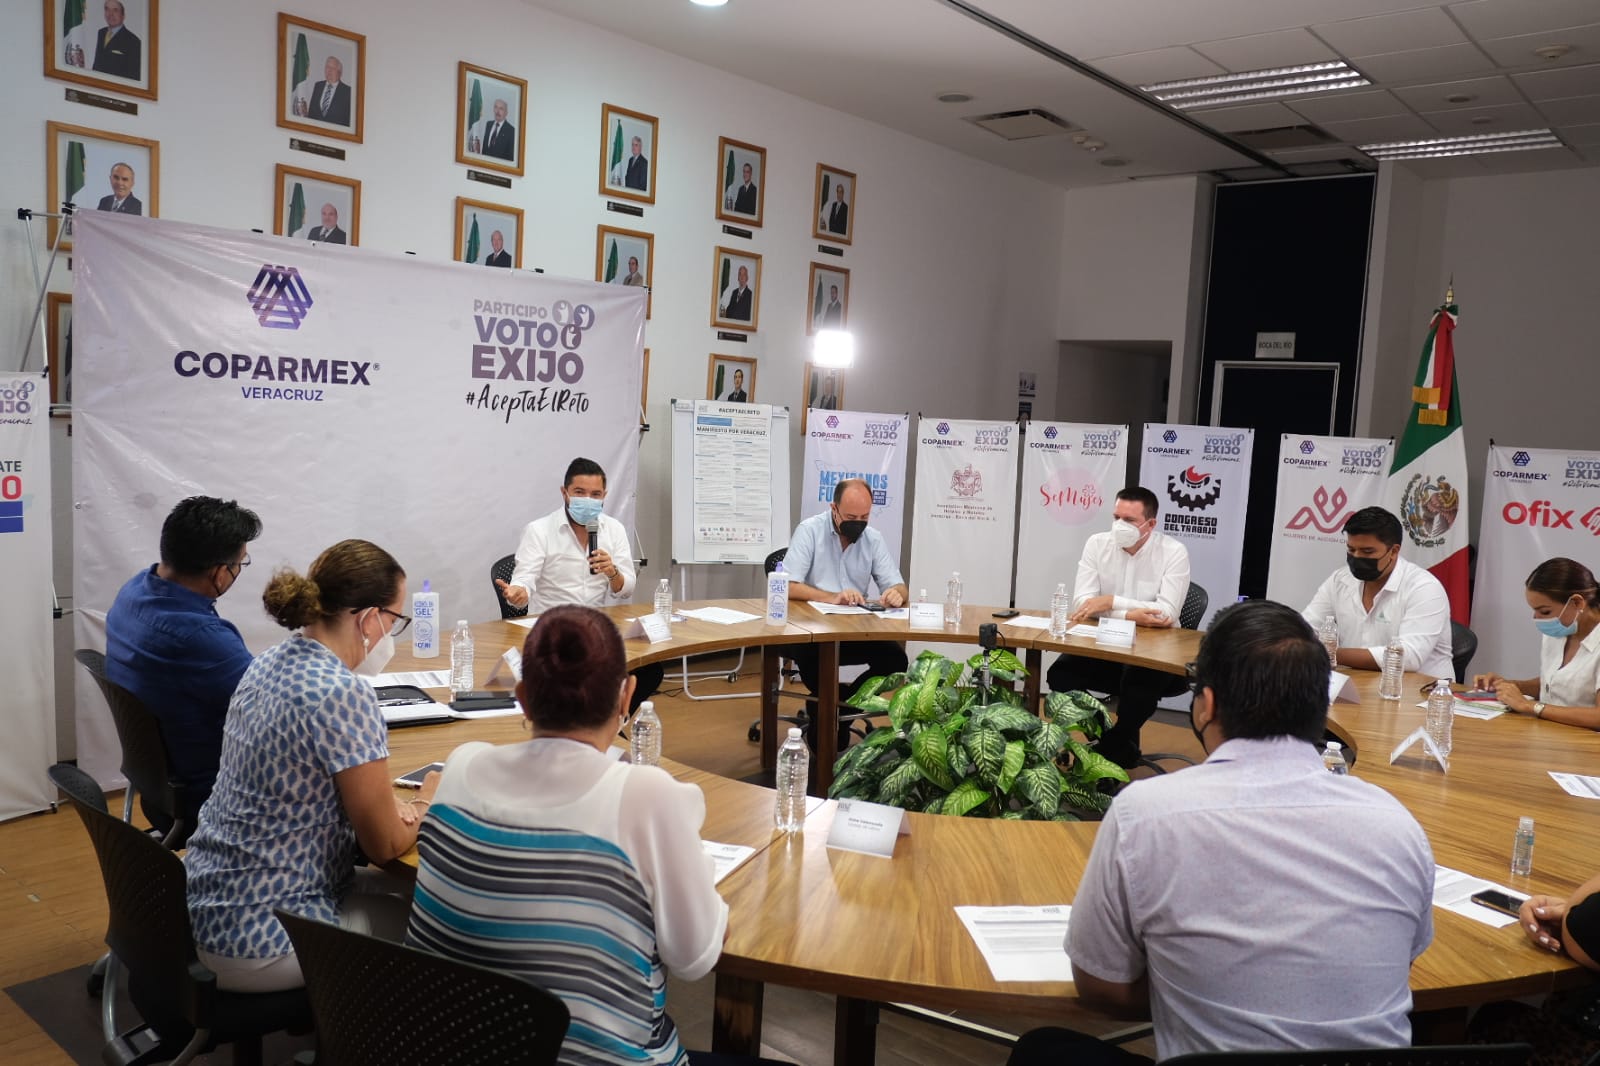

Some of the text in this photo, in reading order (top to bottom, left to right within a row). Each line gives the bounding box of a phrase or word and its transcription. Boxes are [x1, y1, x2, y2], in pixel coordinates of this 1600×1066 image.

[473, 299, 548, 319] PARTICIPO
[474, 315, 558, 348] VOTO
[472, 344, 584, 384] EXIJO
[241, 386, 324, 402] VERACRUZ
[864, 430, 898, 440] EXIJO
[975, 437, 1008, 445] EXIJO
[1082, 440, 1117, 449] EXIJO
[1204, 446, 1240, 455] EXIJO
[1341, 457, 1382, 468] EXIJO
[1493, 470, 1548, 480] COPARMEX
[1164, 513, 1218, 526] CONGRESO
[1502, 500, 1575, 529] Ofix
[1164, 523, 1217, 535] DEL TRABAJO
